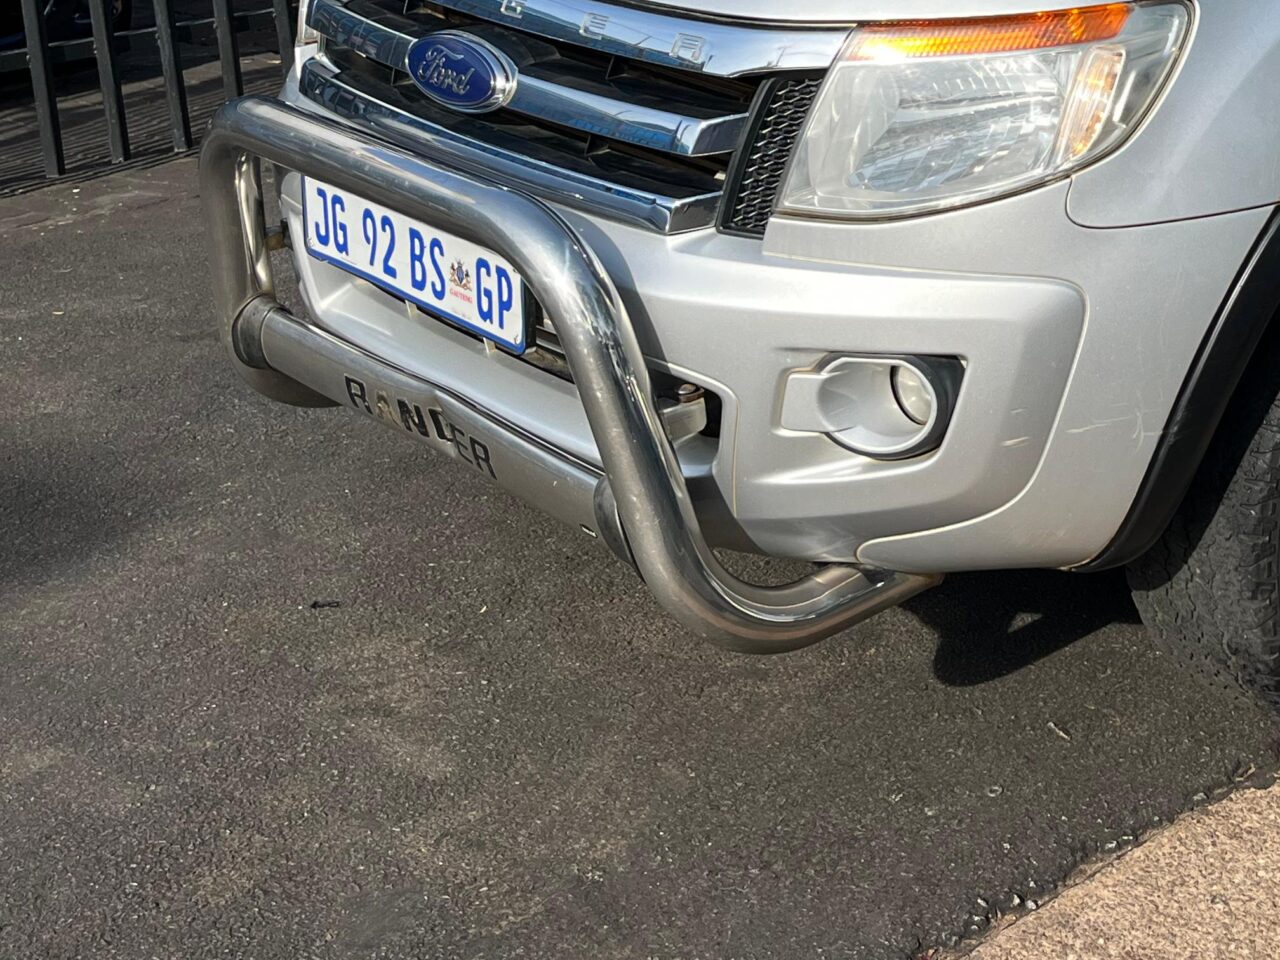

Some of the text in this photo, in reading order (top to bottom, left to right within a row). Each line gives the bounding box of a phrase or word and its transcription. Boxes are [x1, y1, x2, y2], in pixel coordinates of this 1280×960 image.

[416, 44, 474, 97] Ford
[314, 187, 513, 330] JG 92 BS GP
